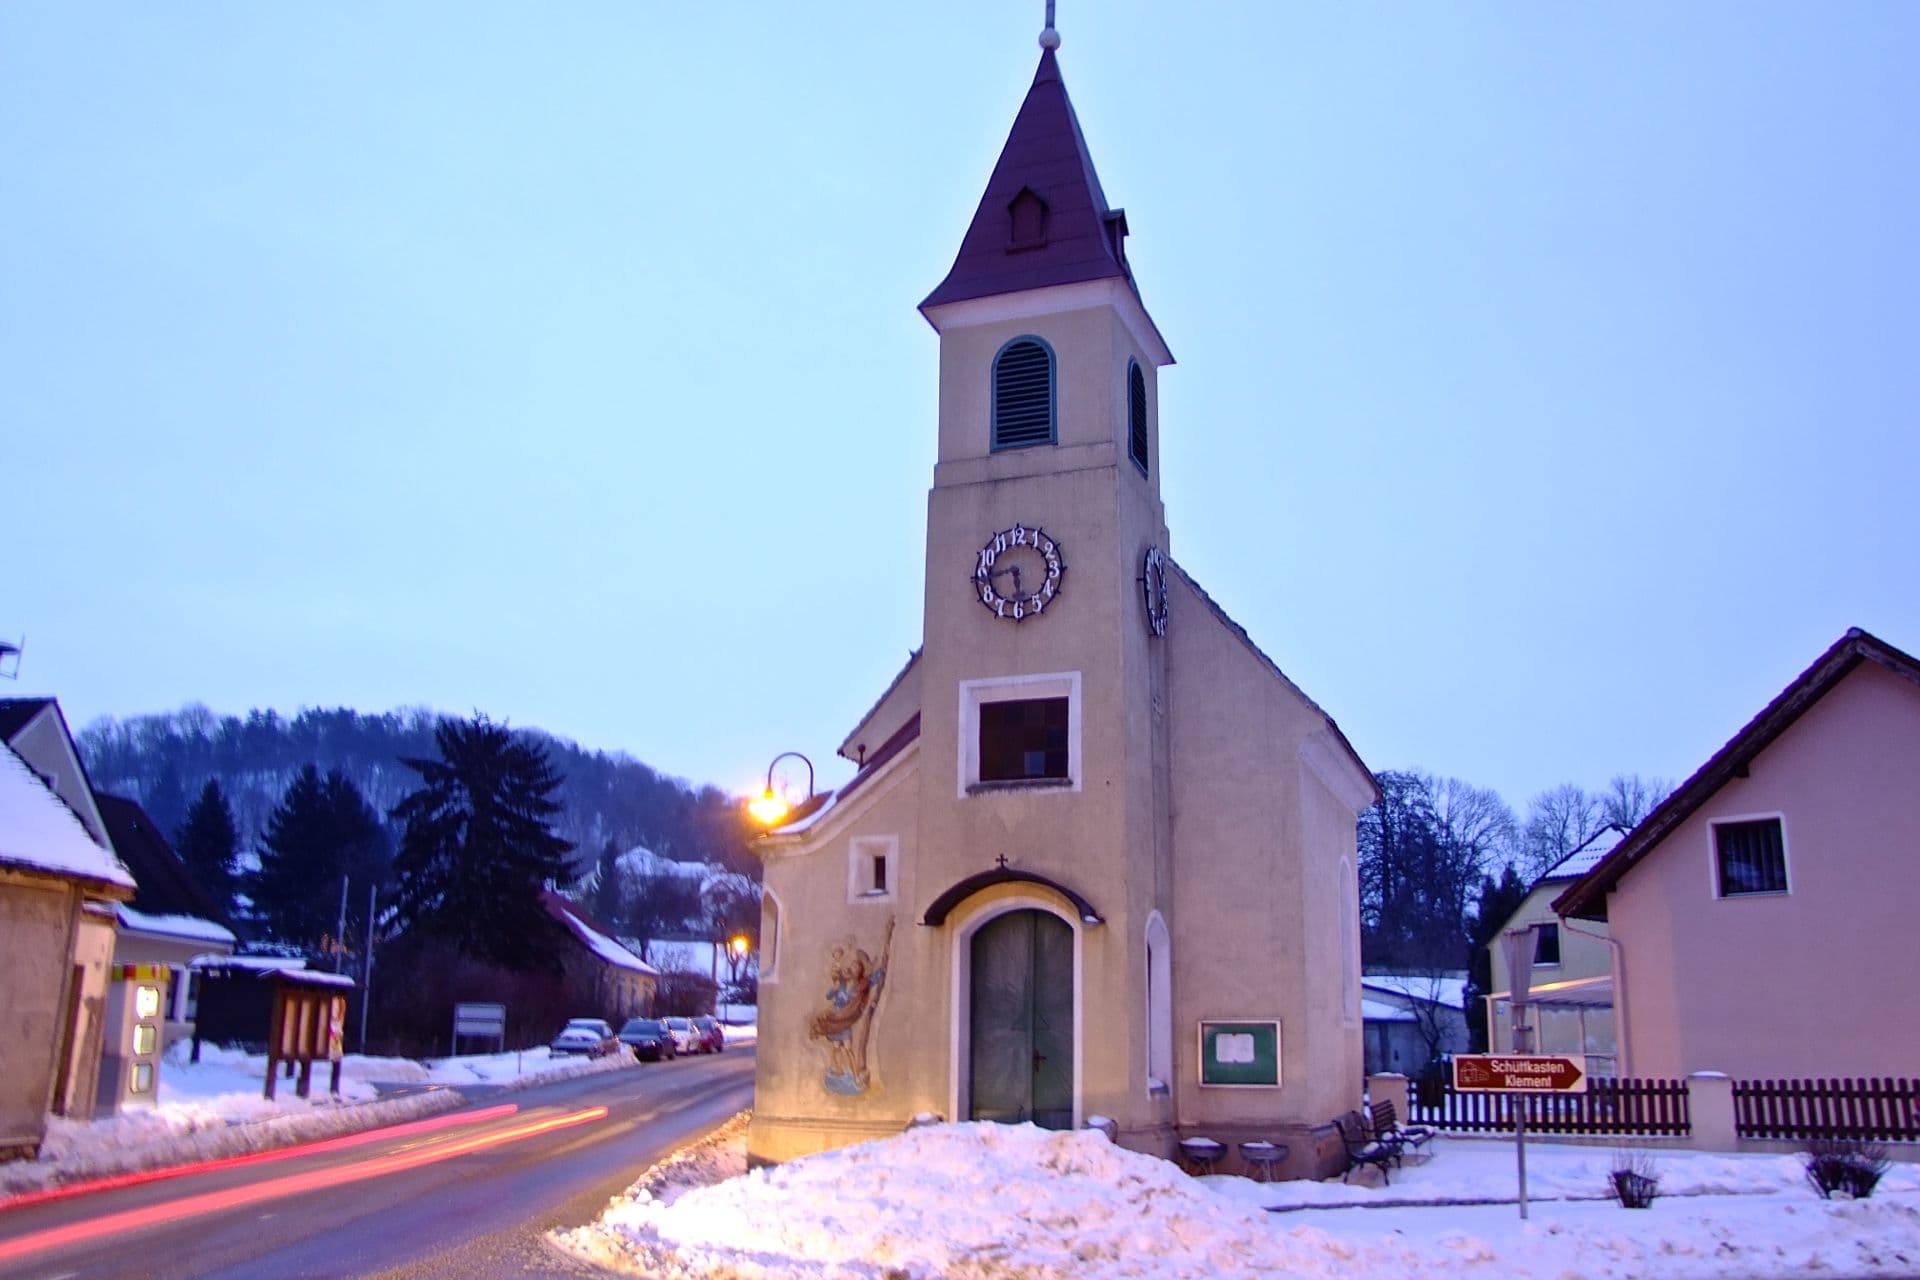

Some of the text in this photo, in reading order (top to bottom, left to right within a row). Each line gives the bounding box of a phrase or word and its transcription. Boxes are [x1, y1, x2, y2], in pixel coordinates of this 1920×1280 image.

[995, 534, 1006, 552] 11
[1010, 527, 1026, 546] 12
[1032, 530, 1038, 548] 1
[981, 549, 995, 567] 10
[1044, 541, 1055, 559] 2
[1048, 560, 1060, 578] 3
[983, 585, 994, 602] 8
[1042, 579, 1054, 597] 4
[995, 599, 1006, 616] 7
[1013, 601, 1024, 618] 6
[1031, 594, 1042, 612] 5
[1491, 1060, 1565, 1073] Schüttkasten
[1504, 1074, 1552, 1087] Klement
